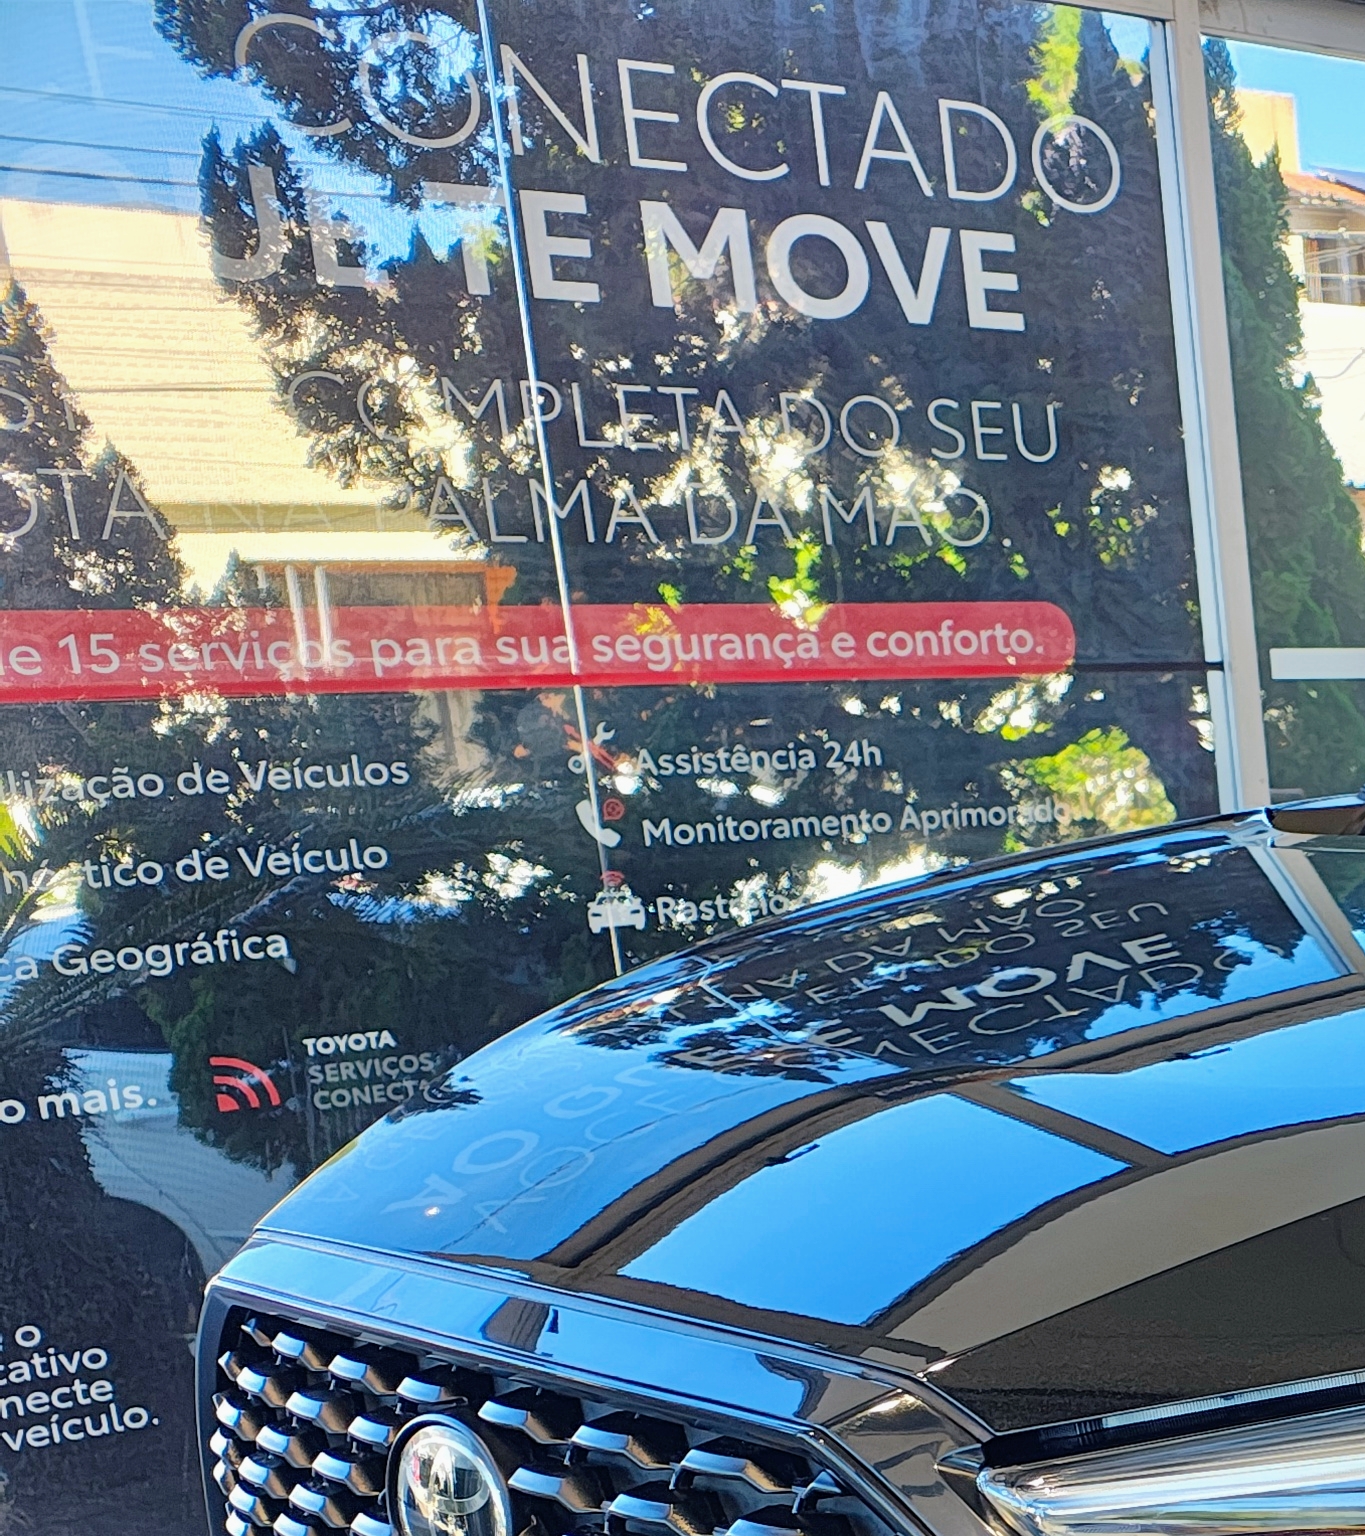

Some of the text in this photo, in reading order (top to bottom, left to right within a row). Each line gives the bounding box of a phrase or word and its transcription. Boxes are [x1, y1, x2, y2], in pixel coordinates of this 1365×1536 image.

[234, 13, 1121, 214] CONECTADO
[639, 200, 1026, 333] MOVE
[287, 371, 1059, 463] COMPLETA DO SEU
[687, 480, 793, 546] DA
[58, 633, 120, 675] 15
[137, 638, 355, 681] serviços
[371, 638, 481, 682] para
[495, 634, 571, 666] sua
[592, 627, 820, 671] segurança
[822, 629, 856, 658] e
[867, 620, 1044, 658] conforto.
[176, 761, 231, 796] de
[238, 751, 410, 793] Veículos
[635, 738, 882, 777] Assistência 24h
[643, 805, 891, 848] Monitoramento
[175, 850, 229, 883] de
[238, 838, 390, 878] Veículo
[52, 930, 289, 980] Geográfica
[302, 1029, 398, 1057] TOYOTA
[308, 1051, 436, 1085] SERVIÇOS
[38, 1076, 158, 1119] mais.
[15, 1325, 41, 1348] o
[1, 1402, 159, 1452] veículo.
